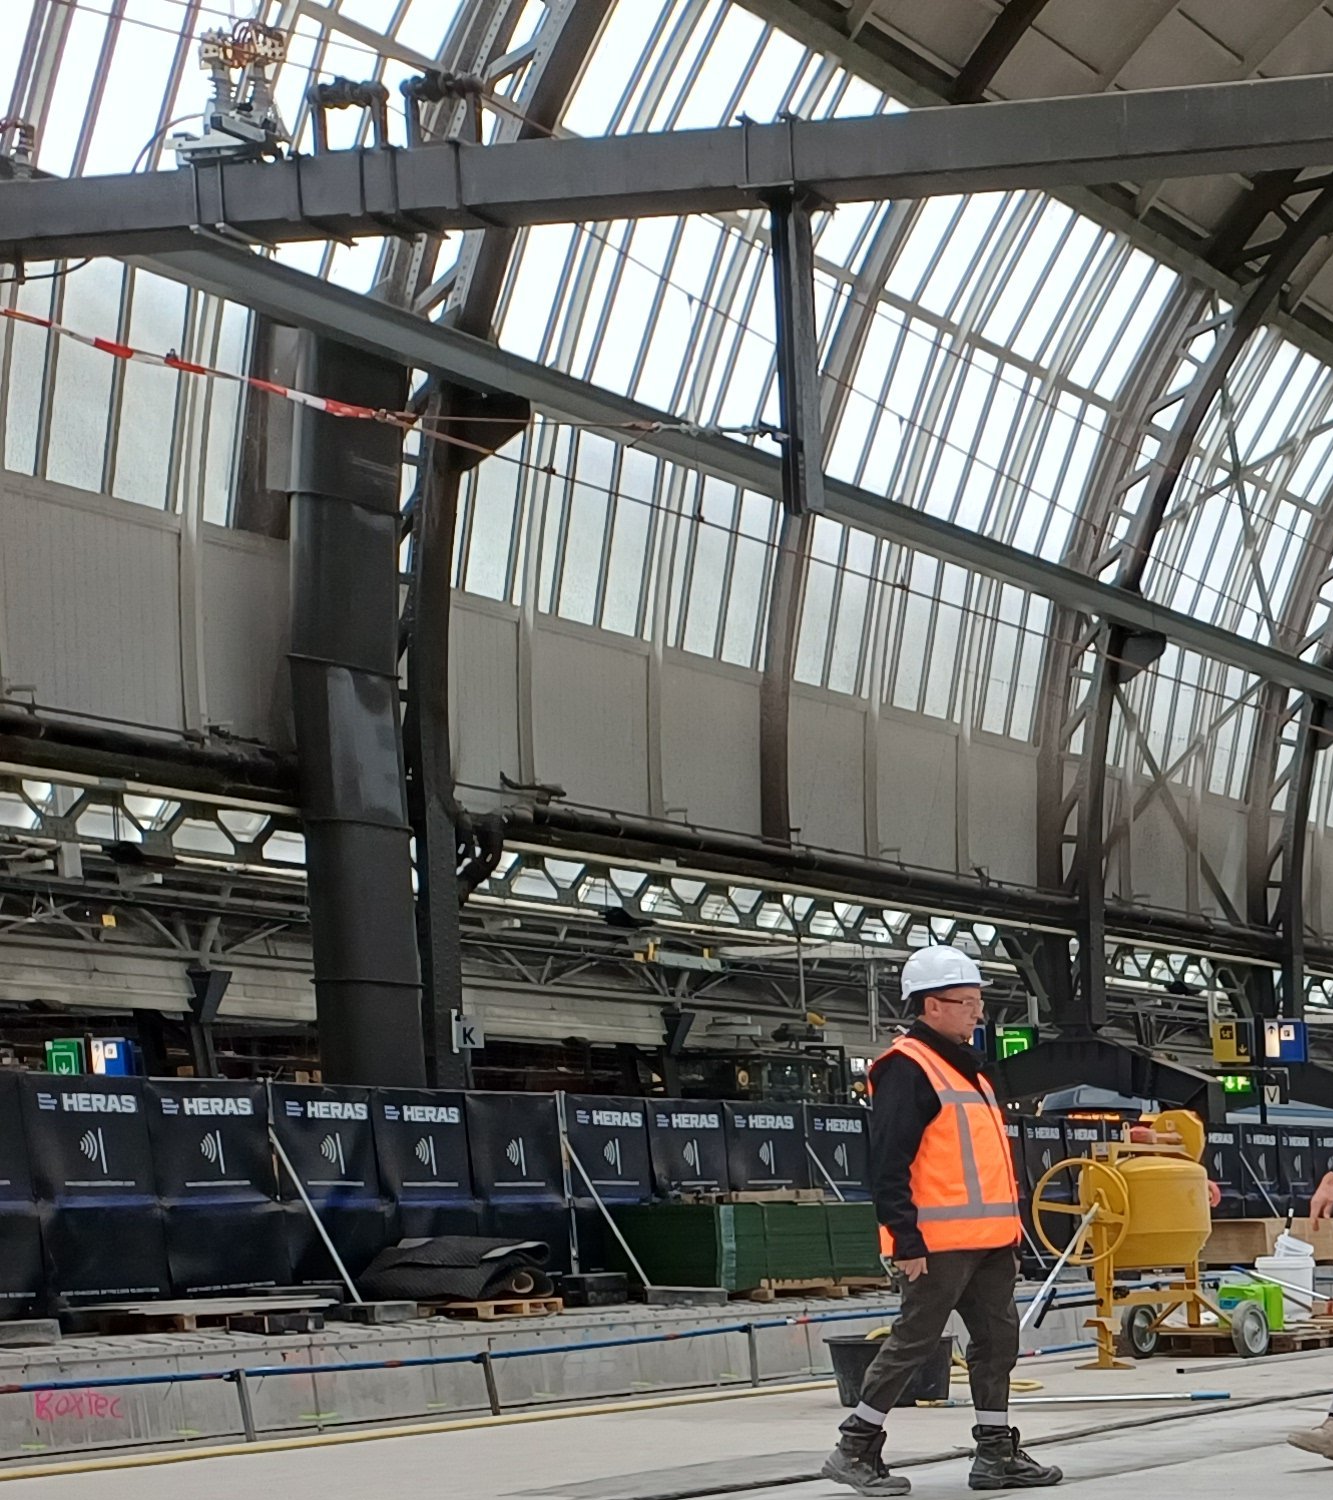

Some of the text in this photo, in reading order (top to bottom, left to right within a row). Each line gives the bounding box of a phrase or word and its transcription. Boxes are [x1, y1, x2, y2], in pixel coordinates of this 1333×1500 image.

[463, 1026, 476, 1045] K
[62, 1093, 137, 1113] HERAS
[1266, 1087, 1278, 1104] V
[183, 1097, 253, 1116] HERAS
[307, 1101, 368, 1120] HERAS
[402, 1105, 460, 1123] HERAS
[592, 1110, 643, 1128] HERAS
[671, 1113, 719, 1129] HERAS
[748, 1115, 794, 1130] HERAS
[825, 1118, 862, 1133] HERAS
[1035, 1127, 1060, 1140] HERAS
